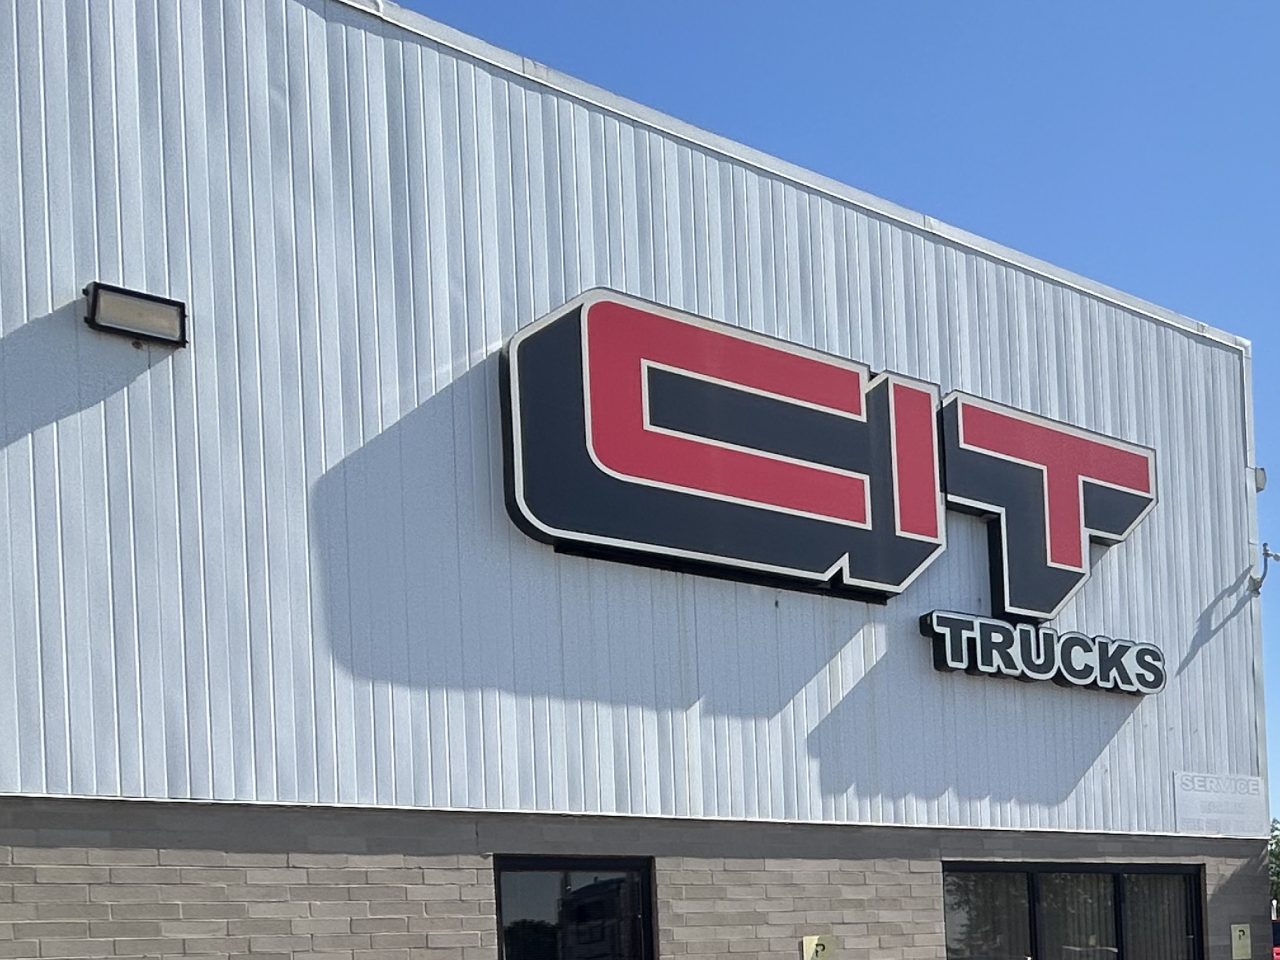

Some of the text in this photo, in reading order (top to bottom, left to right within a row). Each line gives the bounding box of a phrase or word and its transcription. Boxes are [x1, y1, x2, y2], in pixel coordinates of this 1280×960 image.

[507, 287, 1158, 621] CIT
[932, 610, 1167, 694] TRUCKS
[1181, 774, 1260, 796] SERVICE
